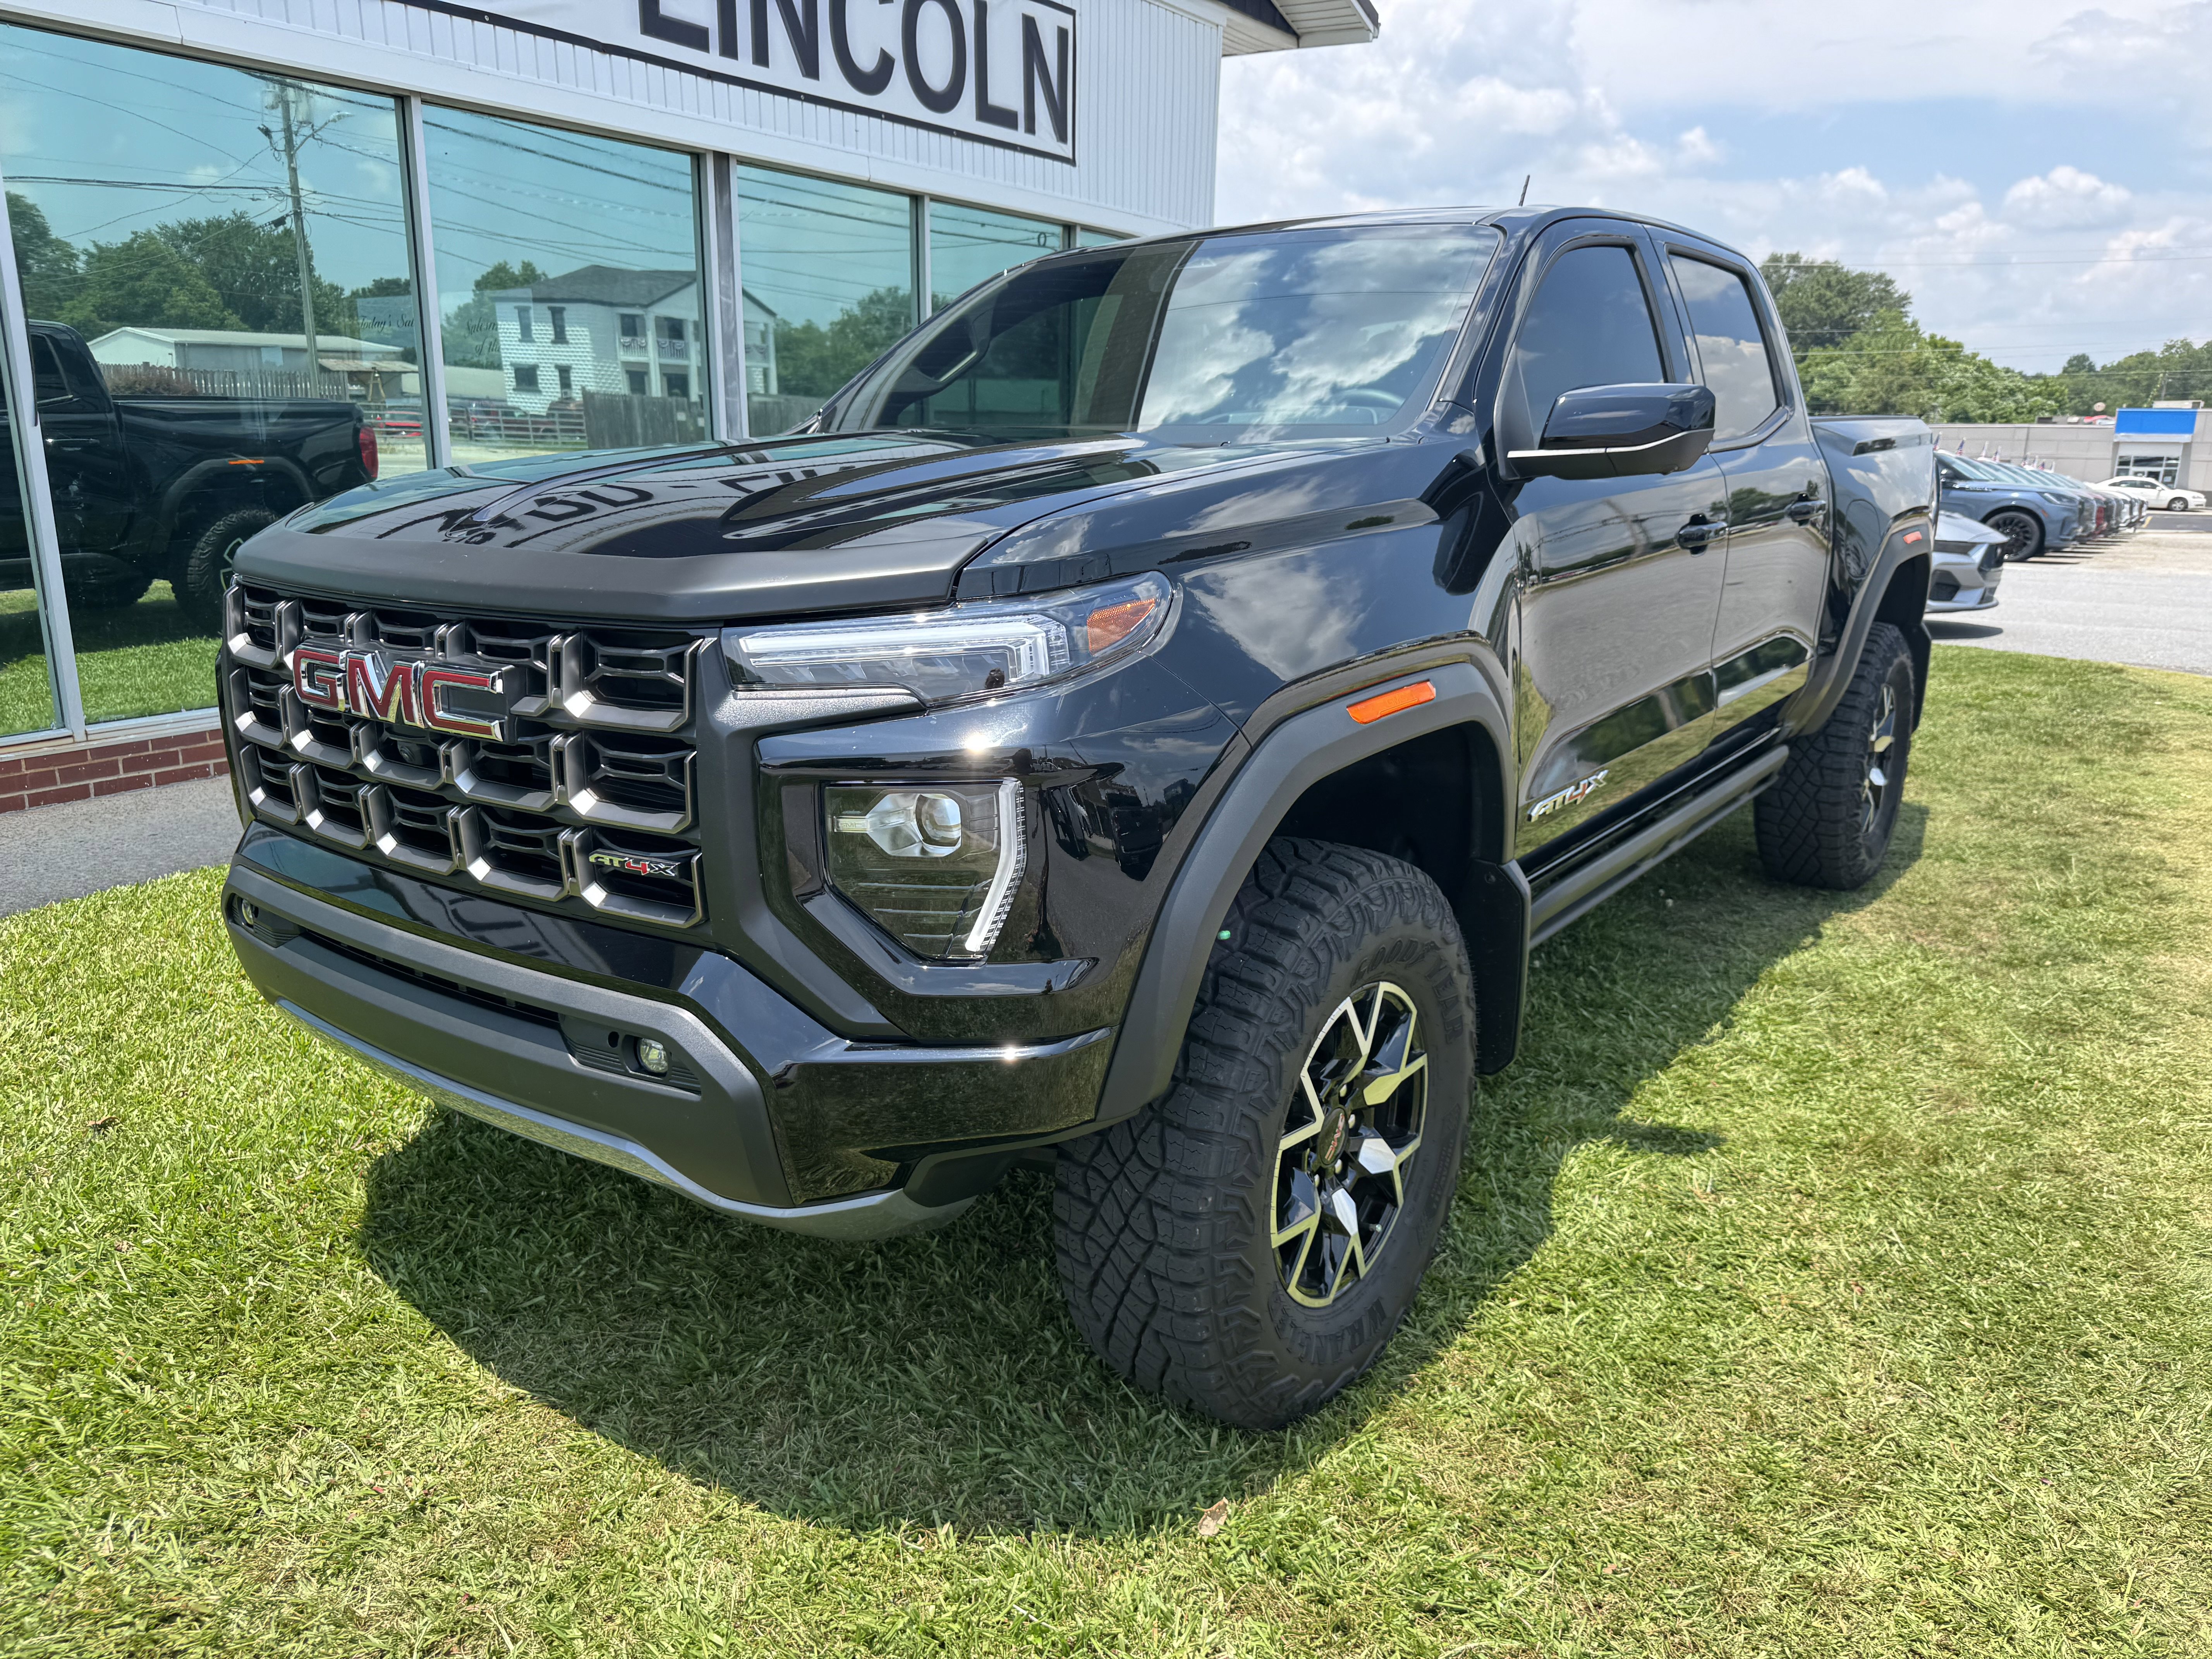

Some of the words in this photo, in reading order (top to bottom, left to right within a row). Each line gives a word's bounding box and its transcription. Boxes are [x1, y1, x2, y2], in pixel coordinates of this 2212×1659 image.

[639, 0, 1068, 144] NCOLN
[359, 314, 391, 333] Today's
[475, 337, 488, 356] of
[293, 644, 503, 742] GMC
[1527, 769, 1609, 822] AT4X
[589, 853, 677, 876] AT4X
[1324, 1113, 1345, 1161] GMC
